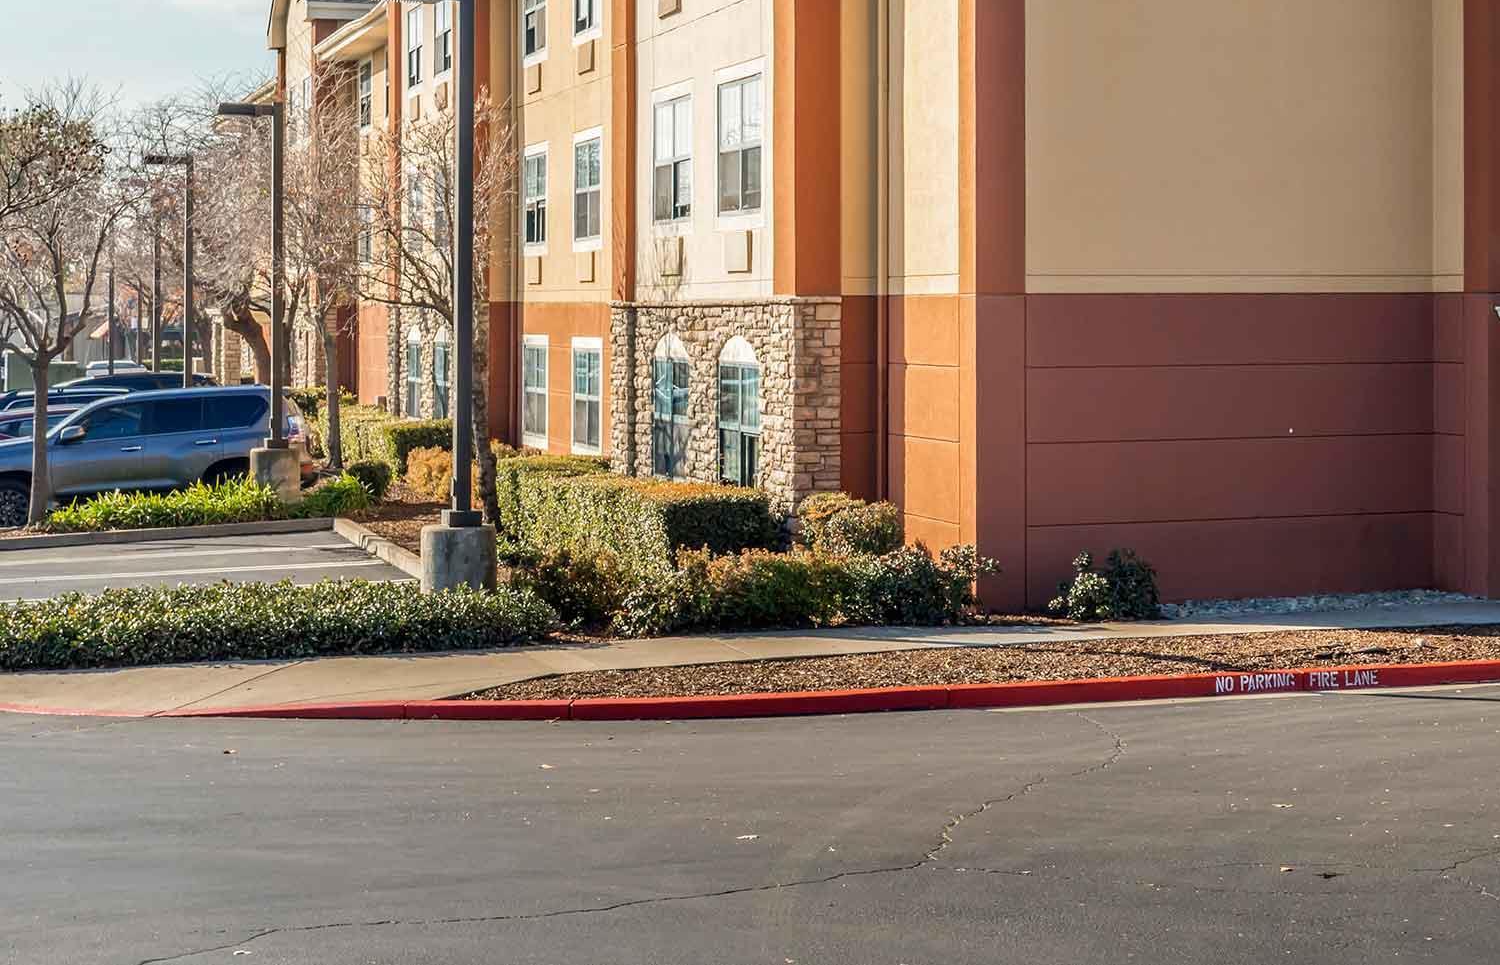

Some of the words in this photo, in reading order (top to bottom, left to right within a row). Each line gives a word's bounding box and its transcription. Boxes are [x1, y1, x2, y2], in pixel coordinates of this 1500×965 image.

[1215, 676, 1234, 693] NO
[1240, 672, 1296, 692] PARKING
[1309, 671, 1339, 687] FIRE
[1344, 669, 1379, 686] LANE
